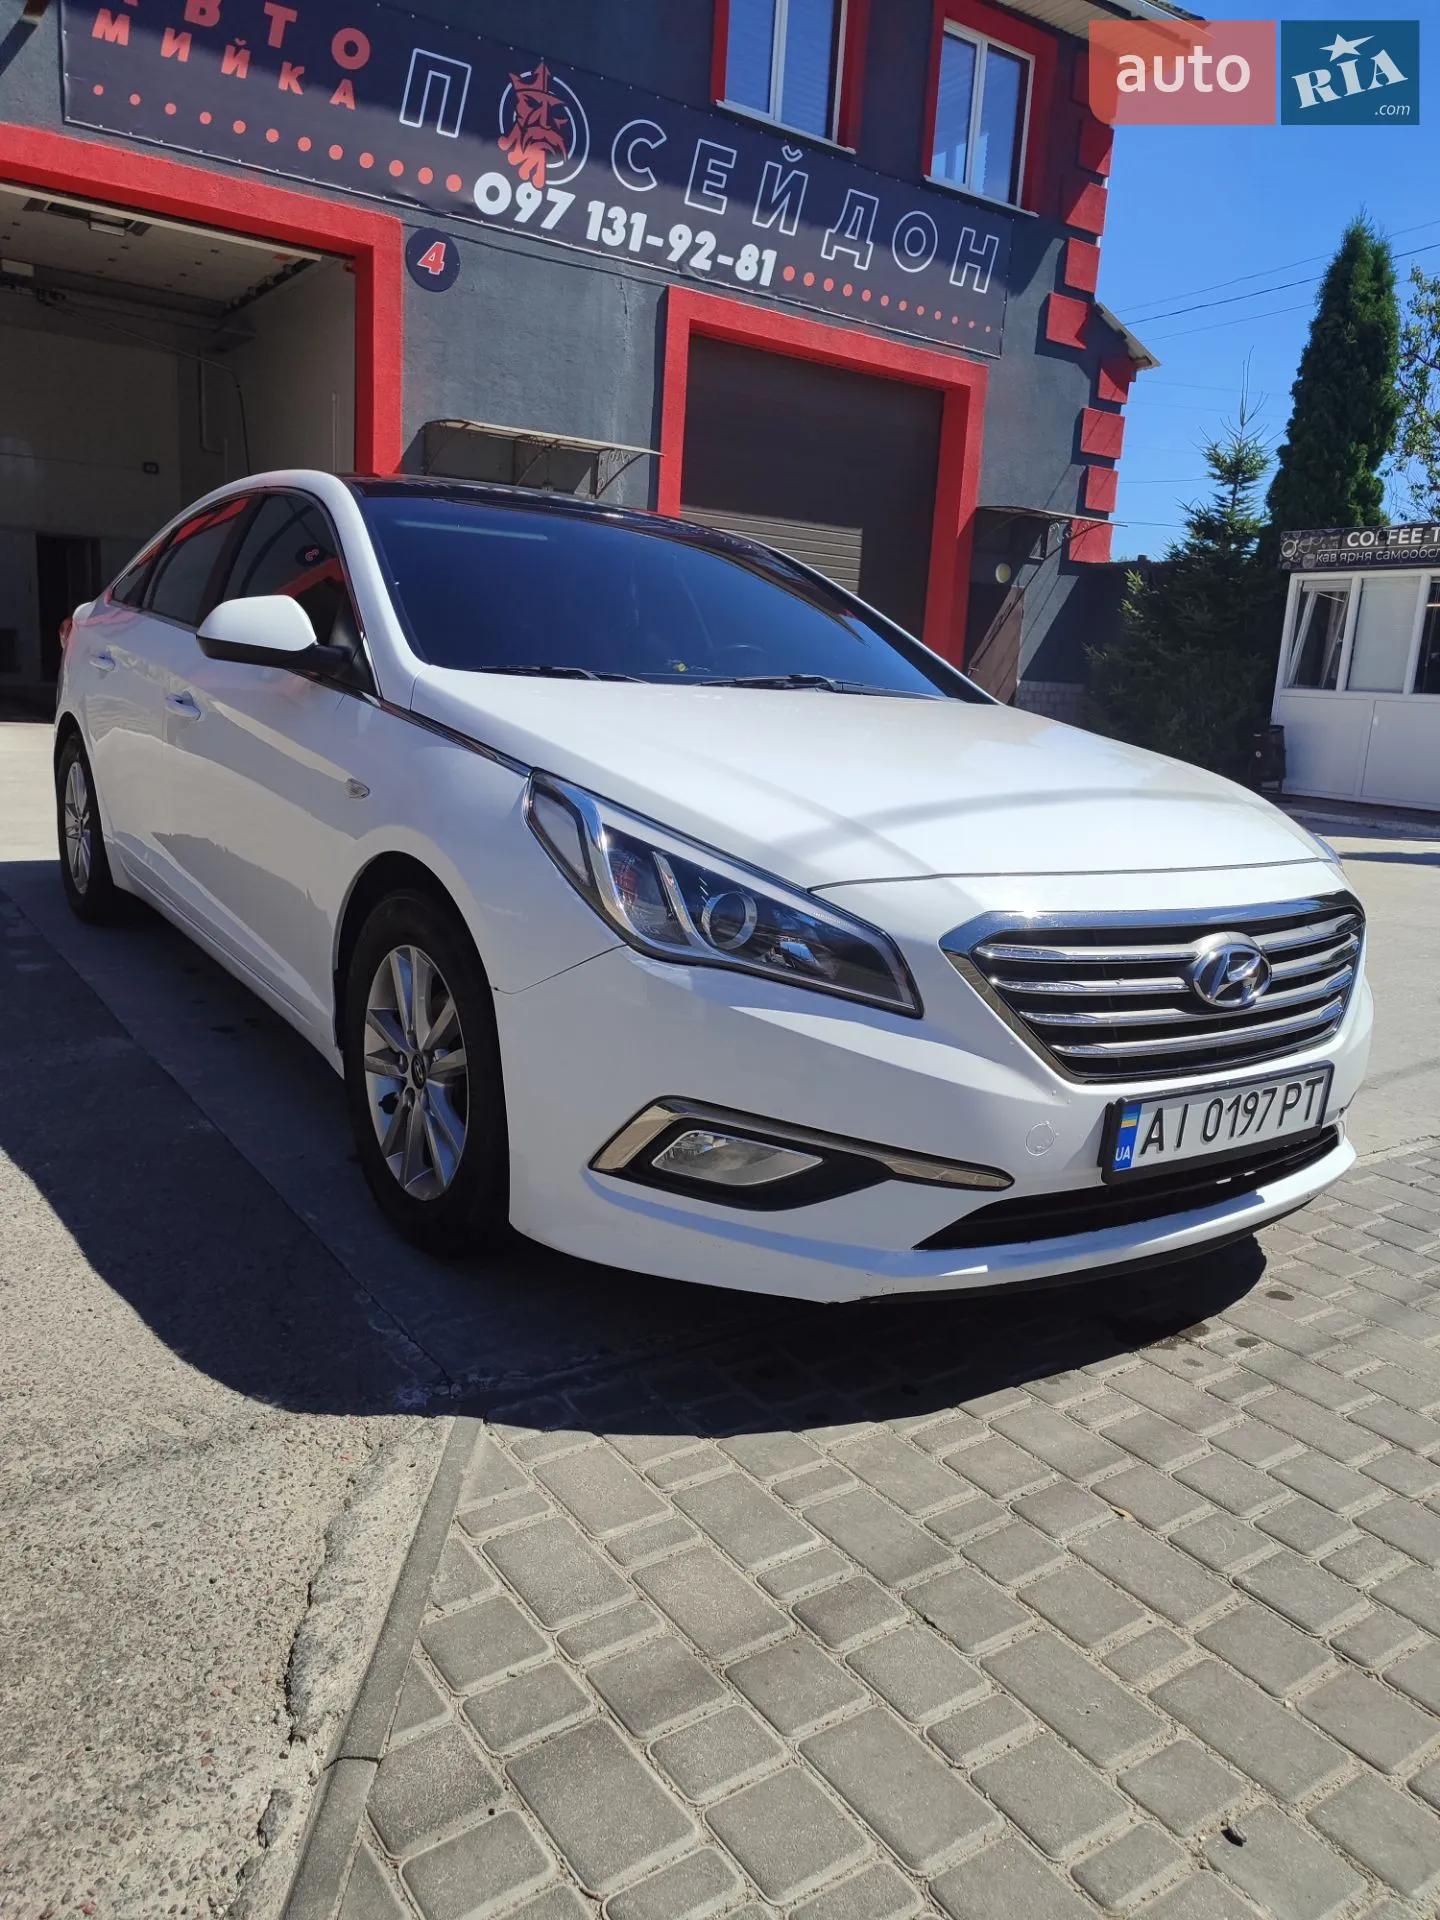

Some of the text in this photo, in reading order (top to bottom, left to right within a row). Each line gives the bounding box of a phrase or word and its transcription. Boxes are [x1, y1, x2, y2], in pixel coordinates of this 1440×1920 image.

[92, 8, 356, 110] МИЙКА
[123, 0, 371, 70] ВТО
[416, 241, 446, 276] 4
[473, 171, 778, 286] 097 131-92-81
[1139, 1076, 1324, 1155] AI 0197 PT
[1115, 1145, 1131, 1162] UA
